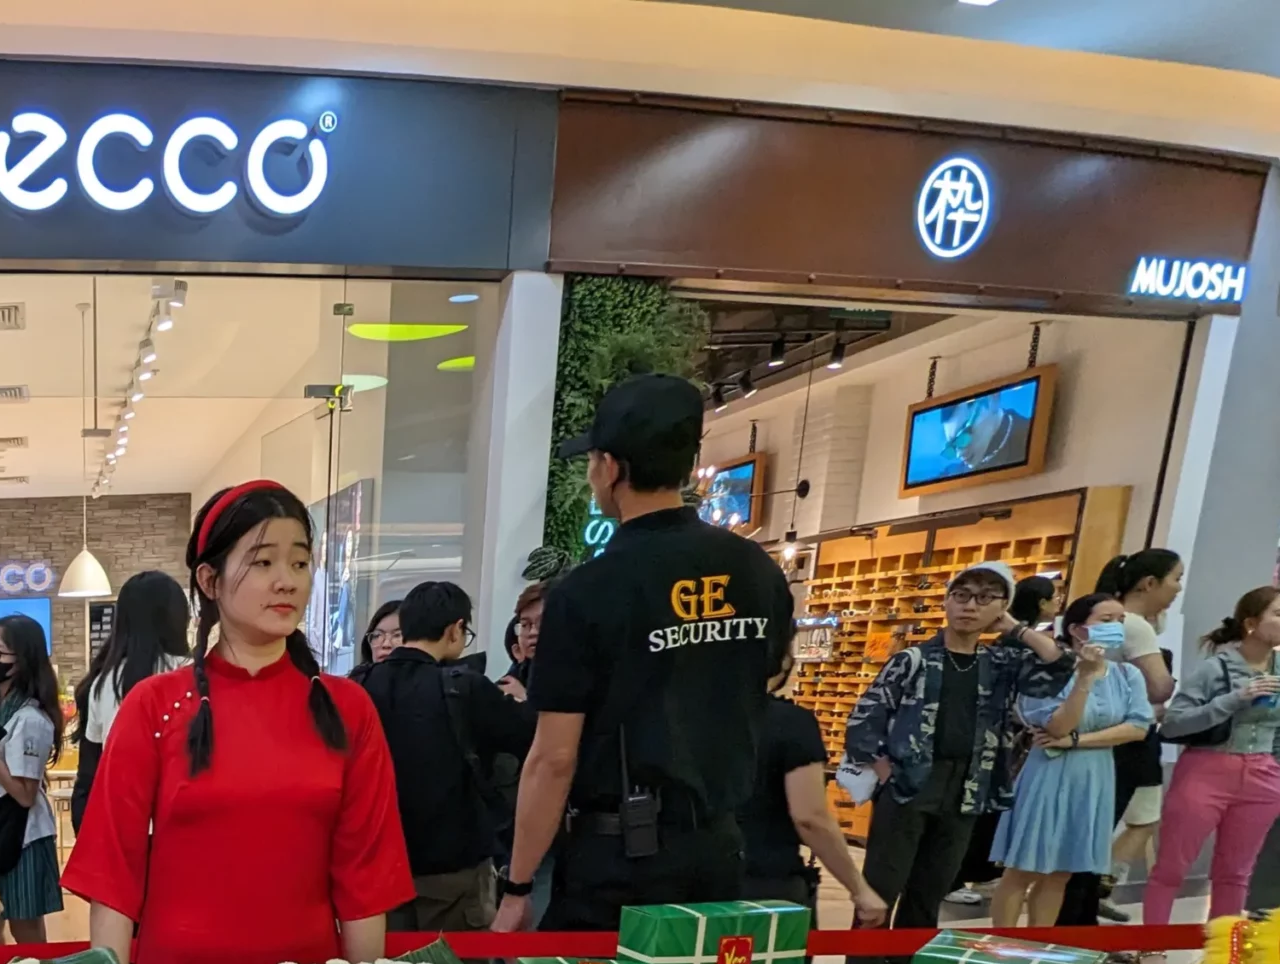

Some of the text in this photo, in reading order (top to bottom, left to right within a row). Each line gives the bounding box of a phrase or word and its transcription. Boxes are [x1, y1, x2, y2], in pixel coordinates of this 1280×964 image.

[1130, 256, 1246, 301] MUJOSH
[671, 575, 736, 621] GE
[649, 617, 768, 652] SECURITY
